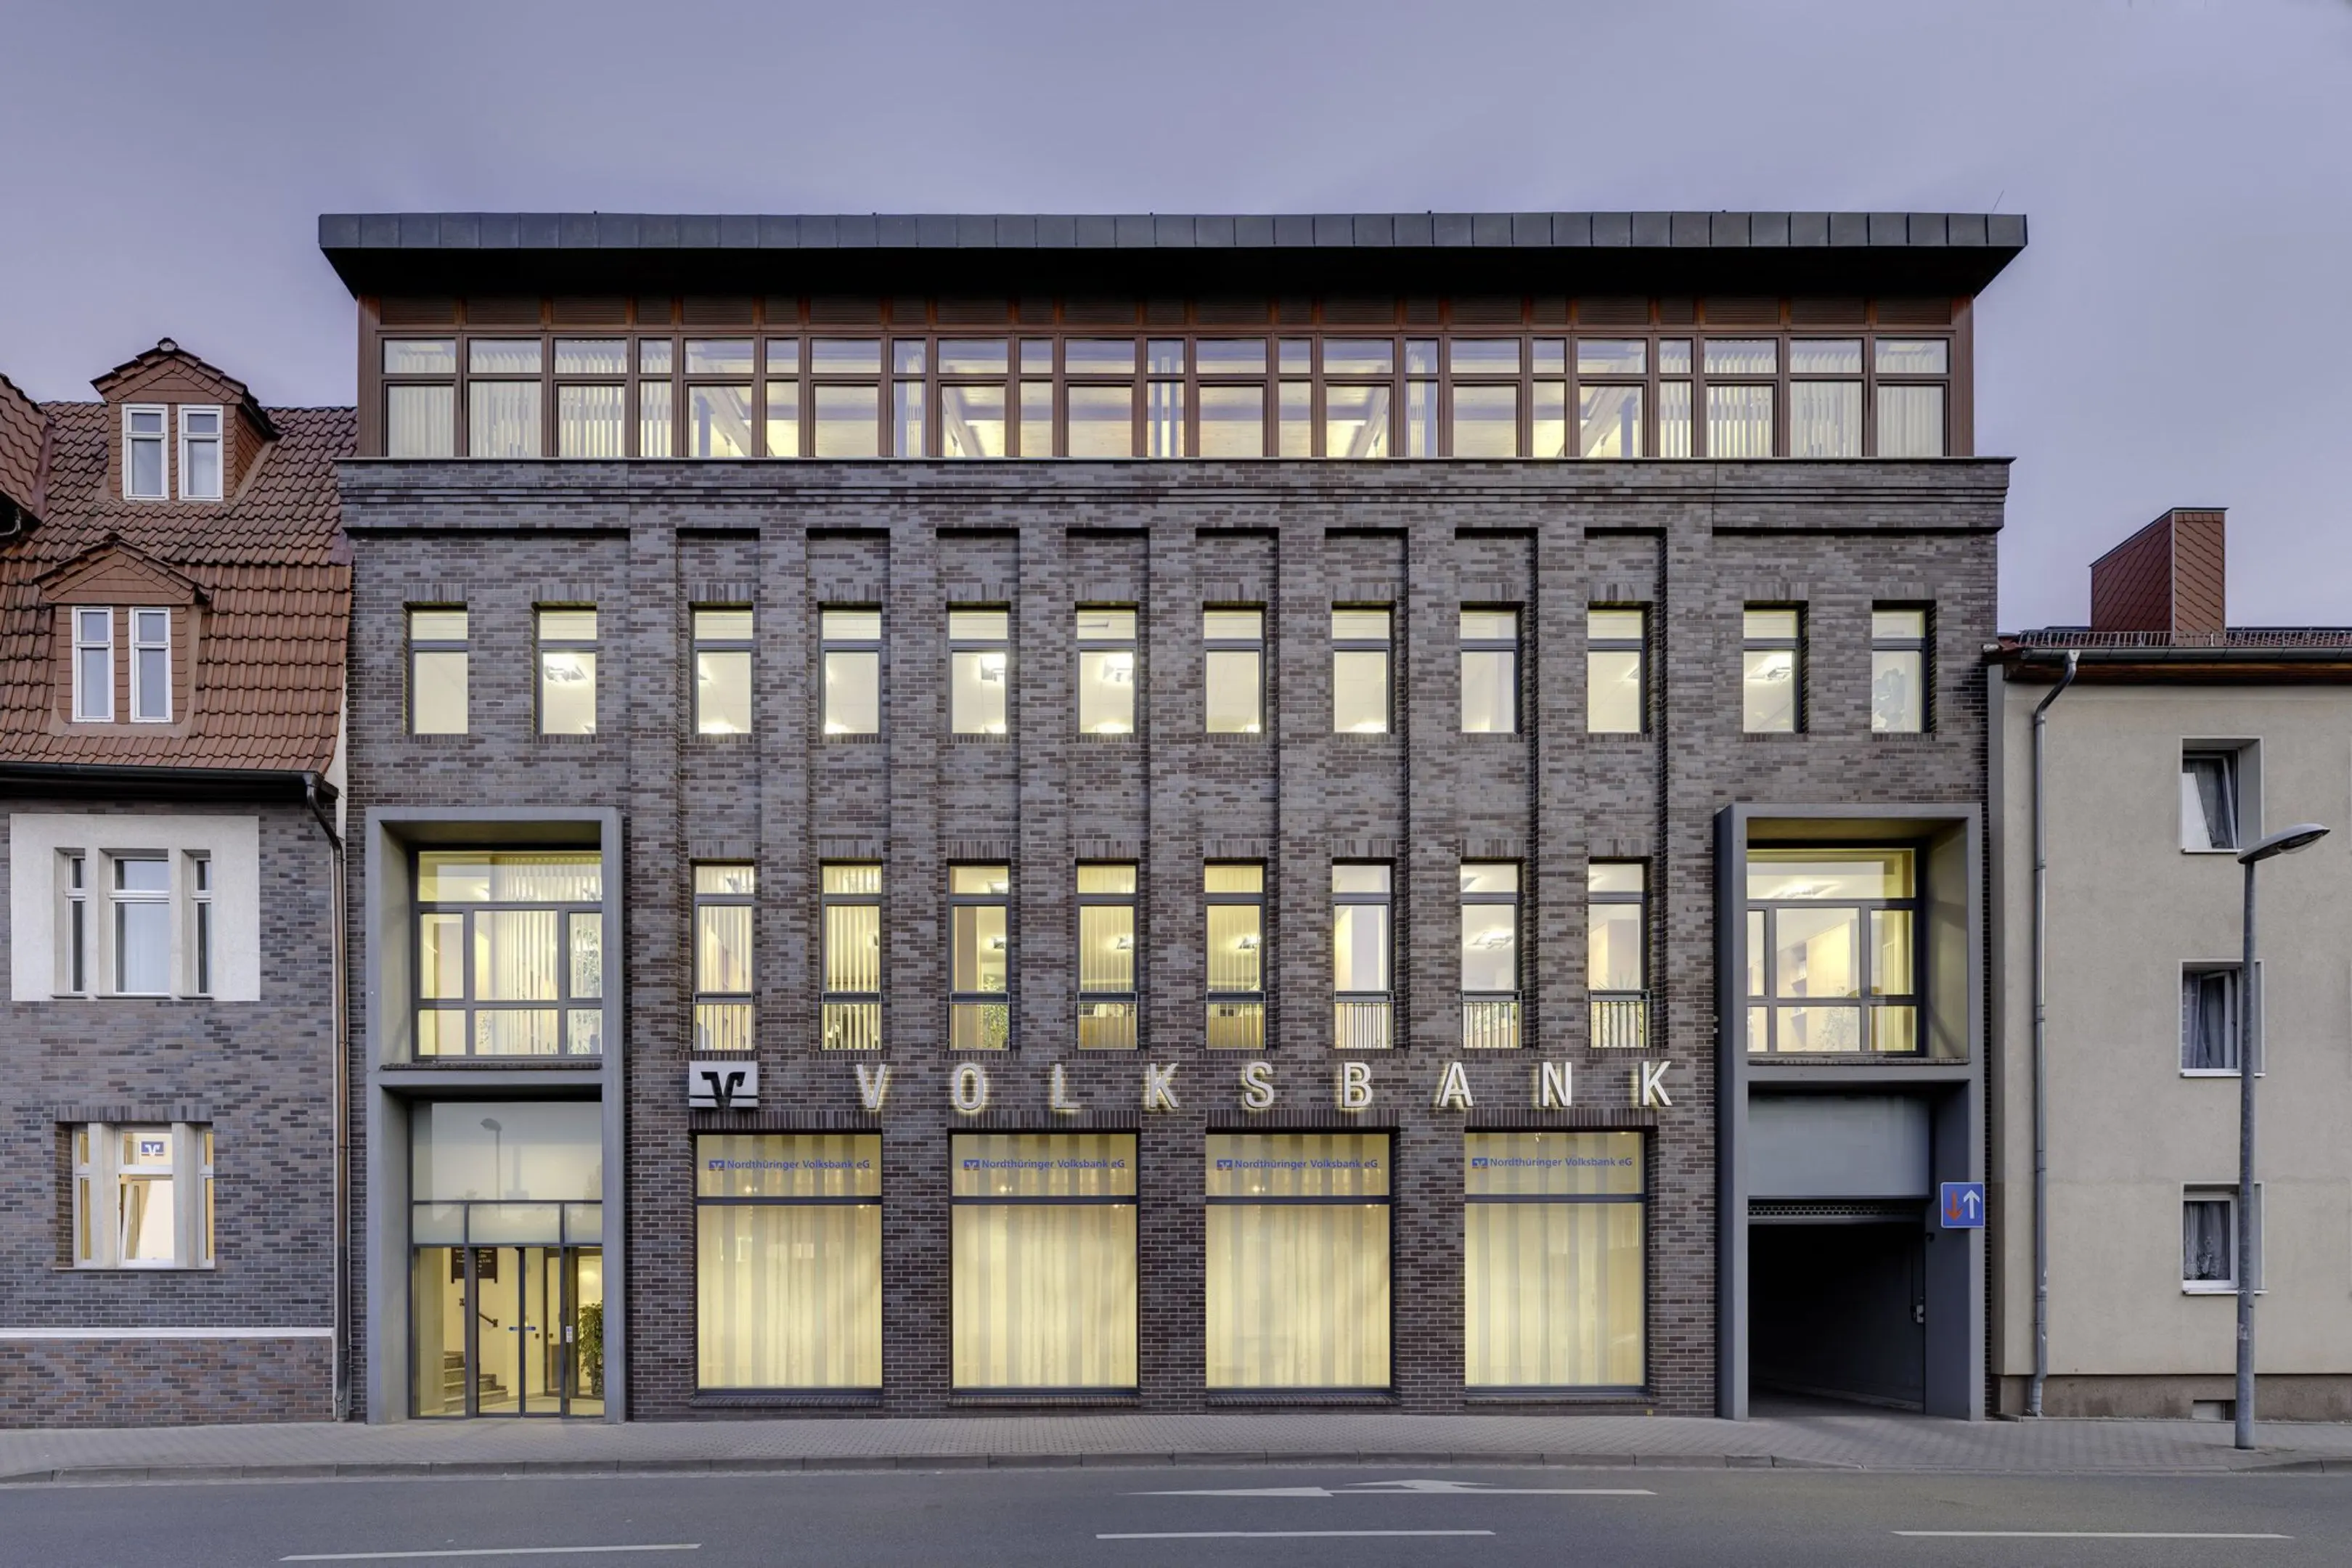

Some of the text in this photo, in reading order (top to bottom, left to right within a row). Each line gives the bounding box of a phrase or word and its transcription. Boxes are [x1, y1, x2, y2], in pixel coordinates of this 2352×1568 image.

[856, 1061, 1673, 1111] VOLKSBANK
[728, 1159, 799, 1170] Nordthüringer
[802, 1159, 853, 1169] Volksbank
[982, 1159, 1053, 1170] Nordthüringer
[1057, 1159, 1108, 1169] Volksbank
[1236, 1159, 1307, 1170] Nordthüringer
[1310, 1159, 1361, 1169] Volksbank
[1490, 1157, 1561, 1168] Nordthüringer
[1565, 1157, 1615, 1167] Volksbank
